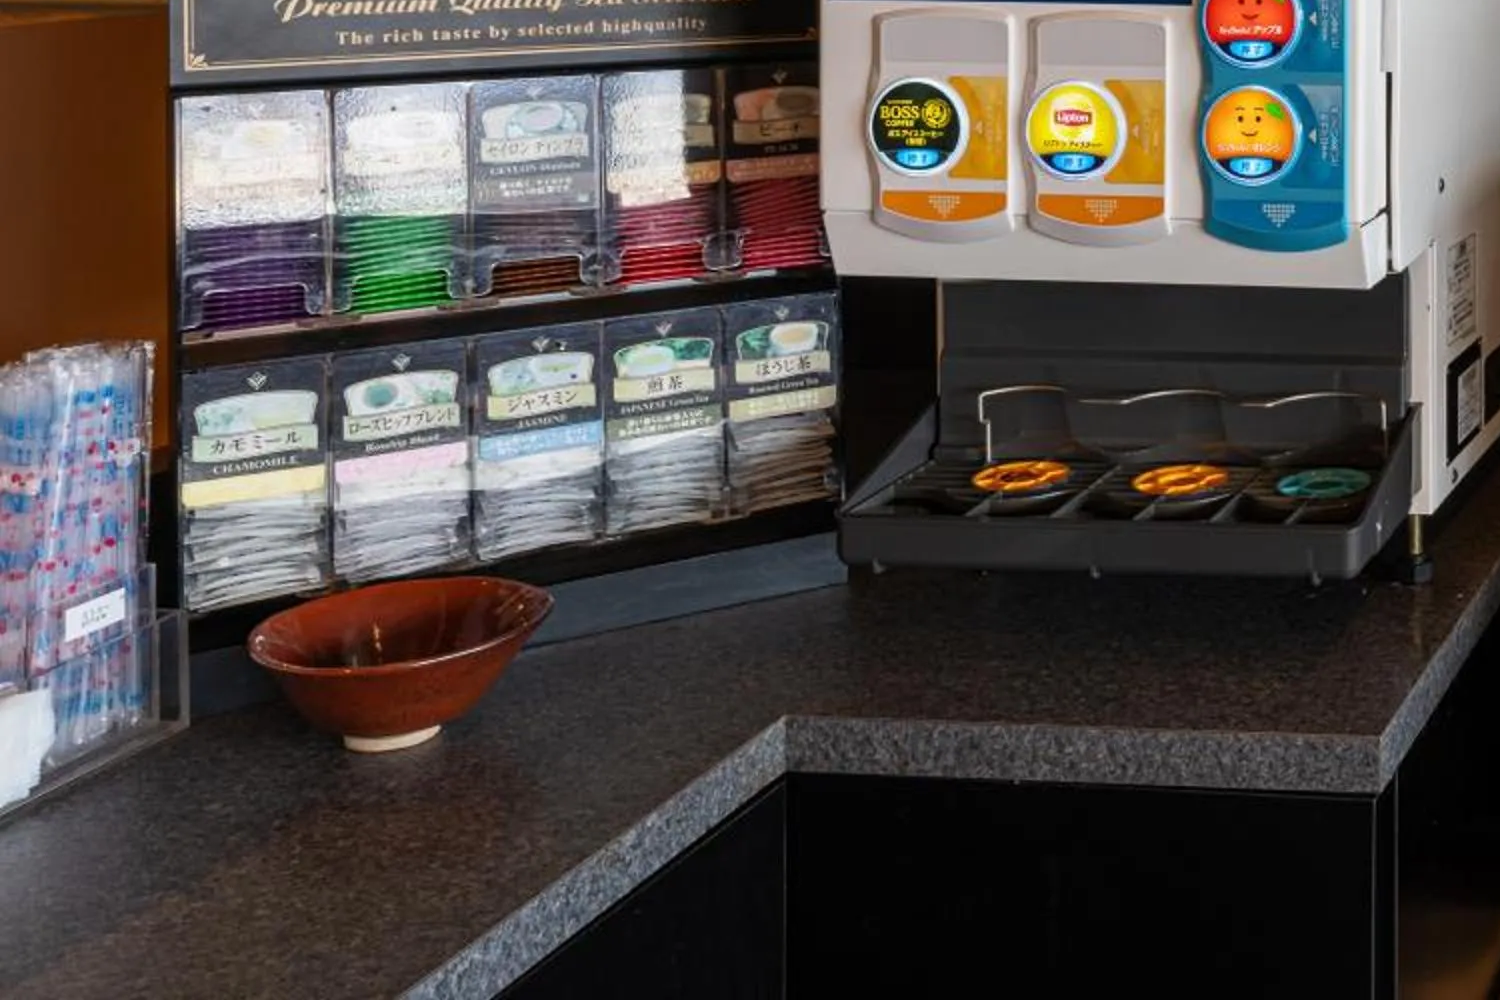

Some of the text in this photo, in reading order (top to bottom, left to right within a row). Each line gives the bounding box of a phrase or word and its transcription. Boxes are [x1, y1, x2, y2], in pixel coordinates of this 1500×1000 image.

[336, 31, 375, 46] The
[383, 29, 424, 44] rich
[433, 28, 481, 42] taste
[489, 25, 508, 40] by
[517, 22, 595, 38] selected
[880, 105, 921, 120] BOSS
